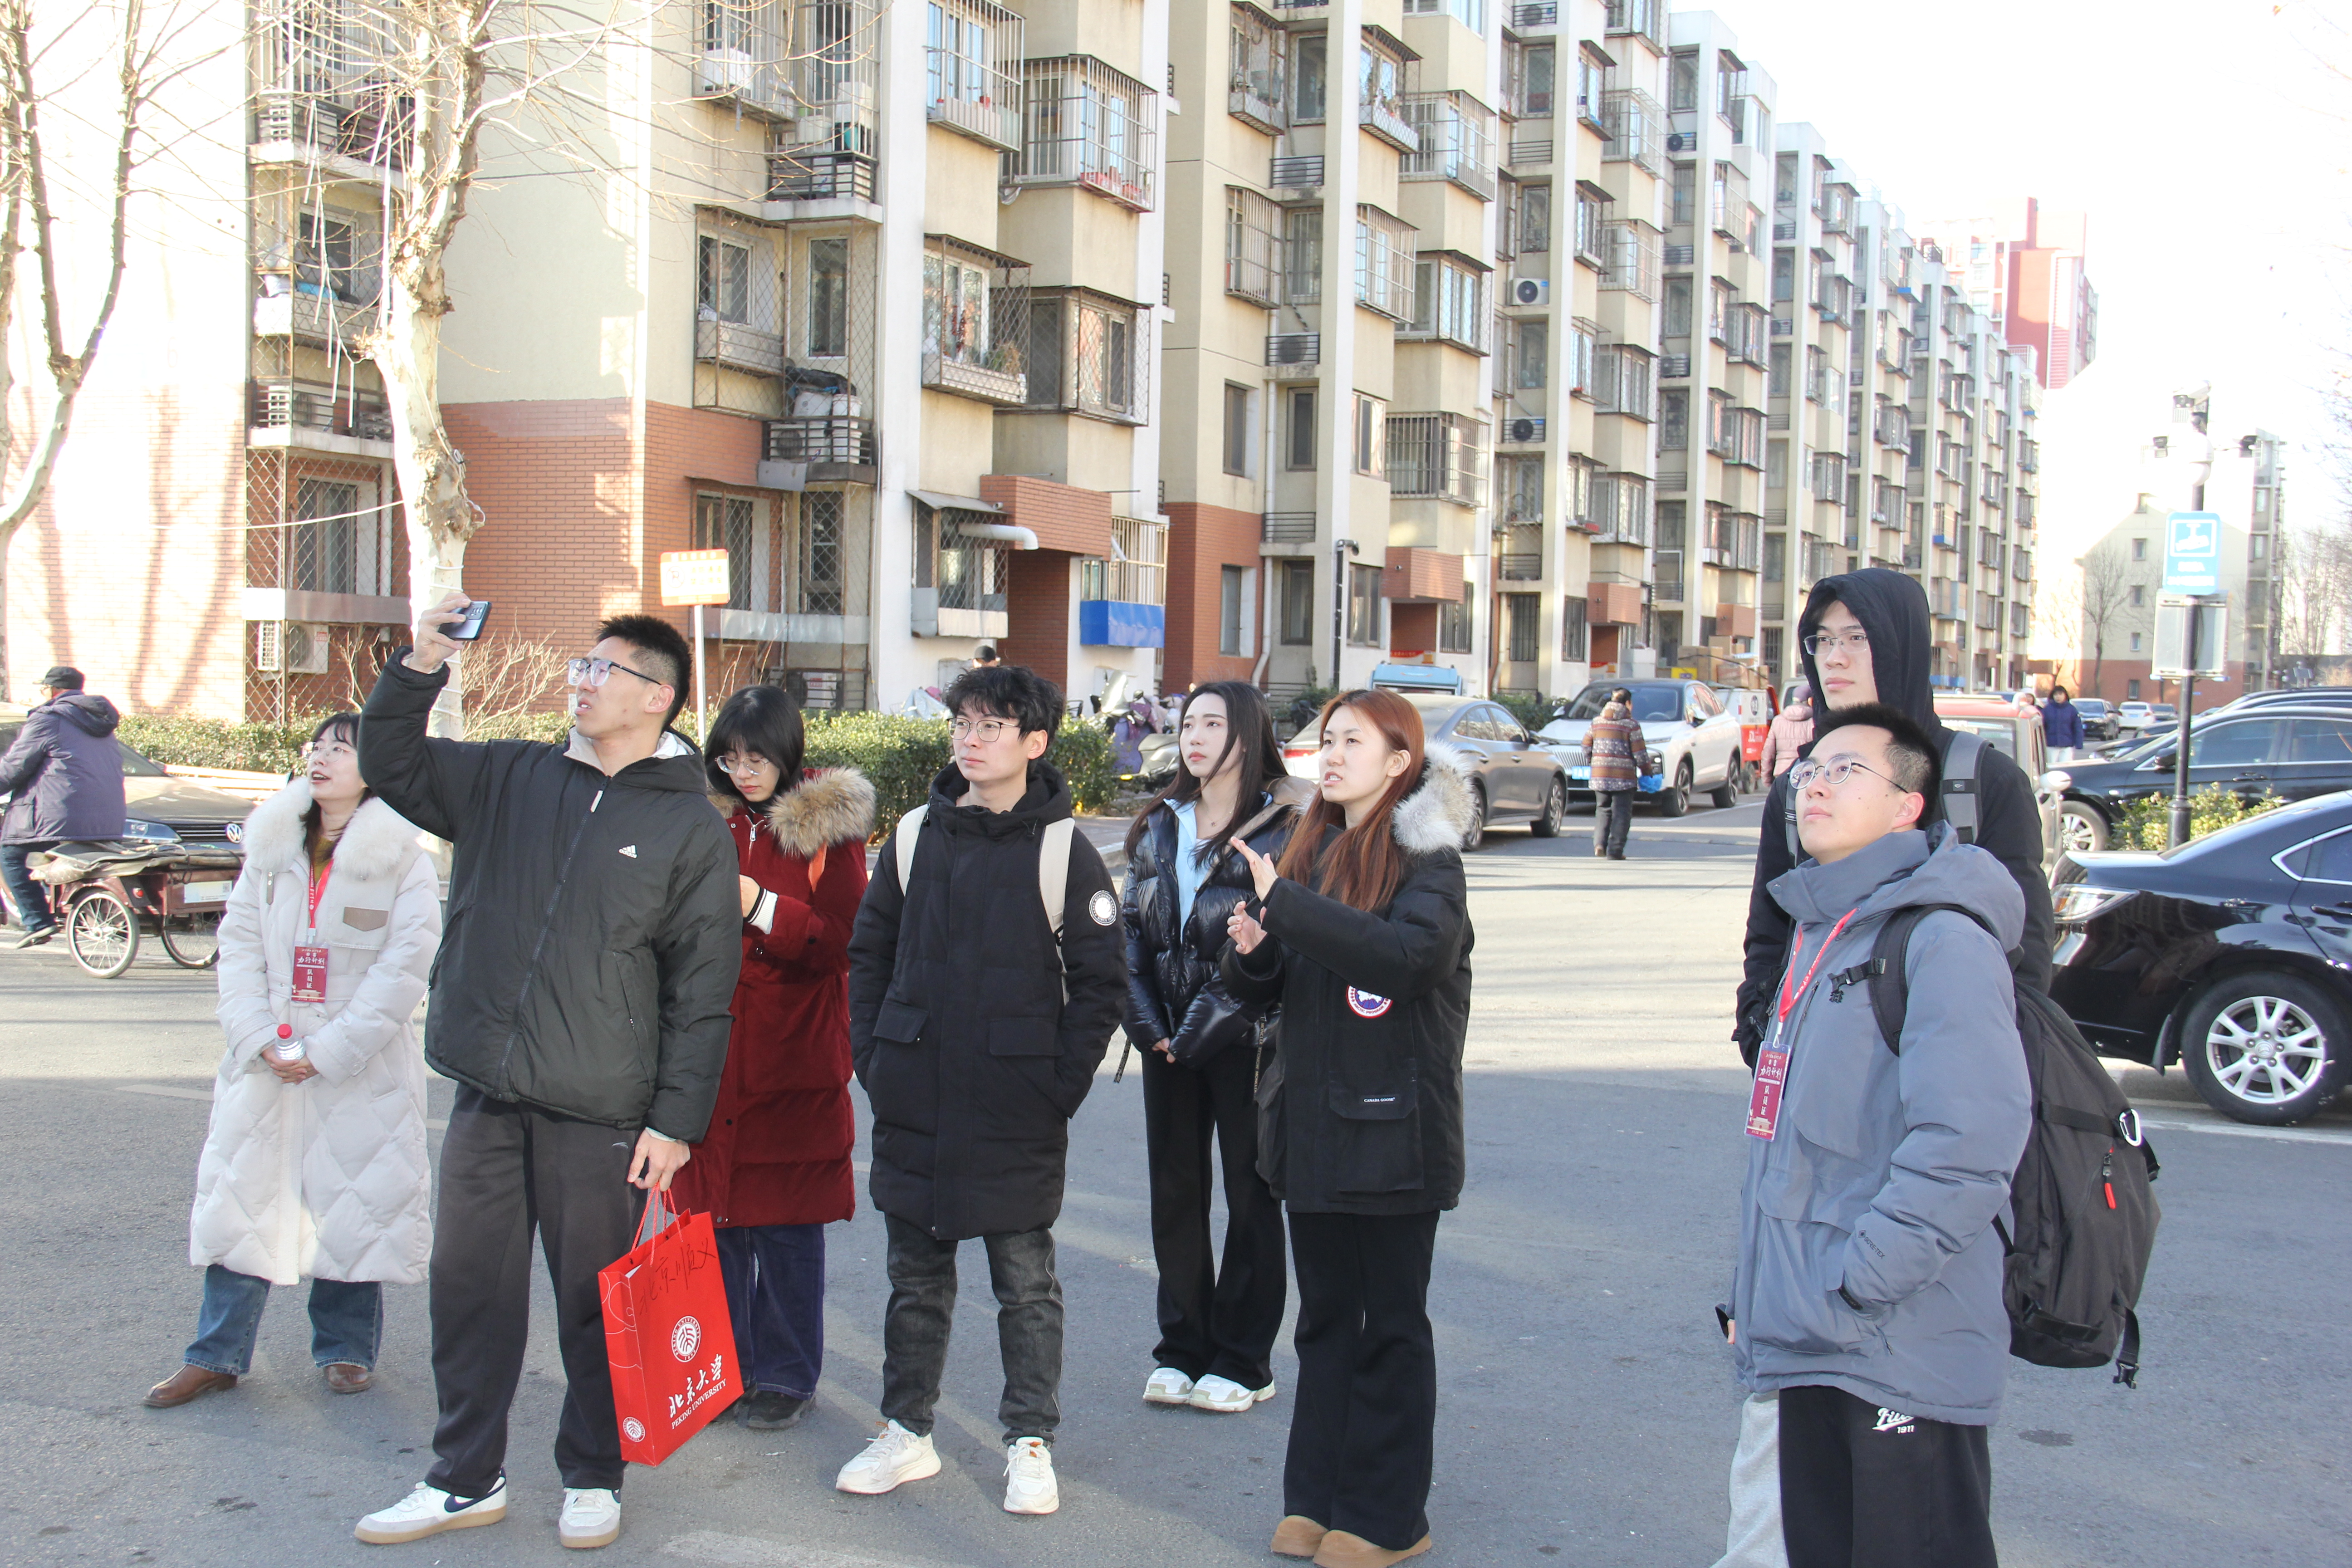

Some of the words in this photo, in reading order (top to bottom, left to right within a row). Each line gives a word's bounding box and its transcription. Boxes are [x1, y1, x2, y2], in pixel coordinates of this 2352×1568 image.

[297, 956, 325, 965] 力行计划
[1353, 1003, 1365, 1013] ARCTIC
[1759, 1064, 1783, 1081] 力行计划
[1760, 1085, 1770, 1116] 队员证
[678, 1318, 700, 1339] UNIVERSITY
[668, 1353, 722, 1418] 北京大学
[671, 1407, 692, 1430] PEKING
[691, 1378, 726, 1411] UNIVERSITY
[1896, 1425, 1915, 1434] 1911
